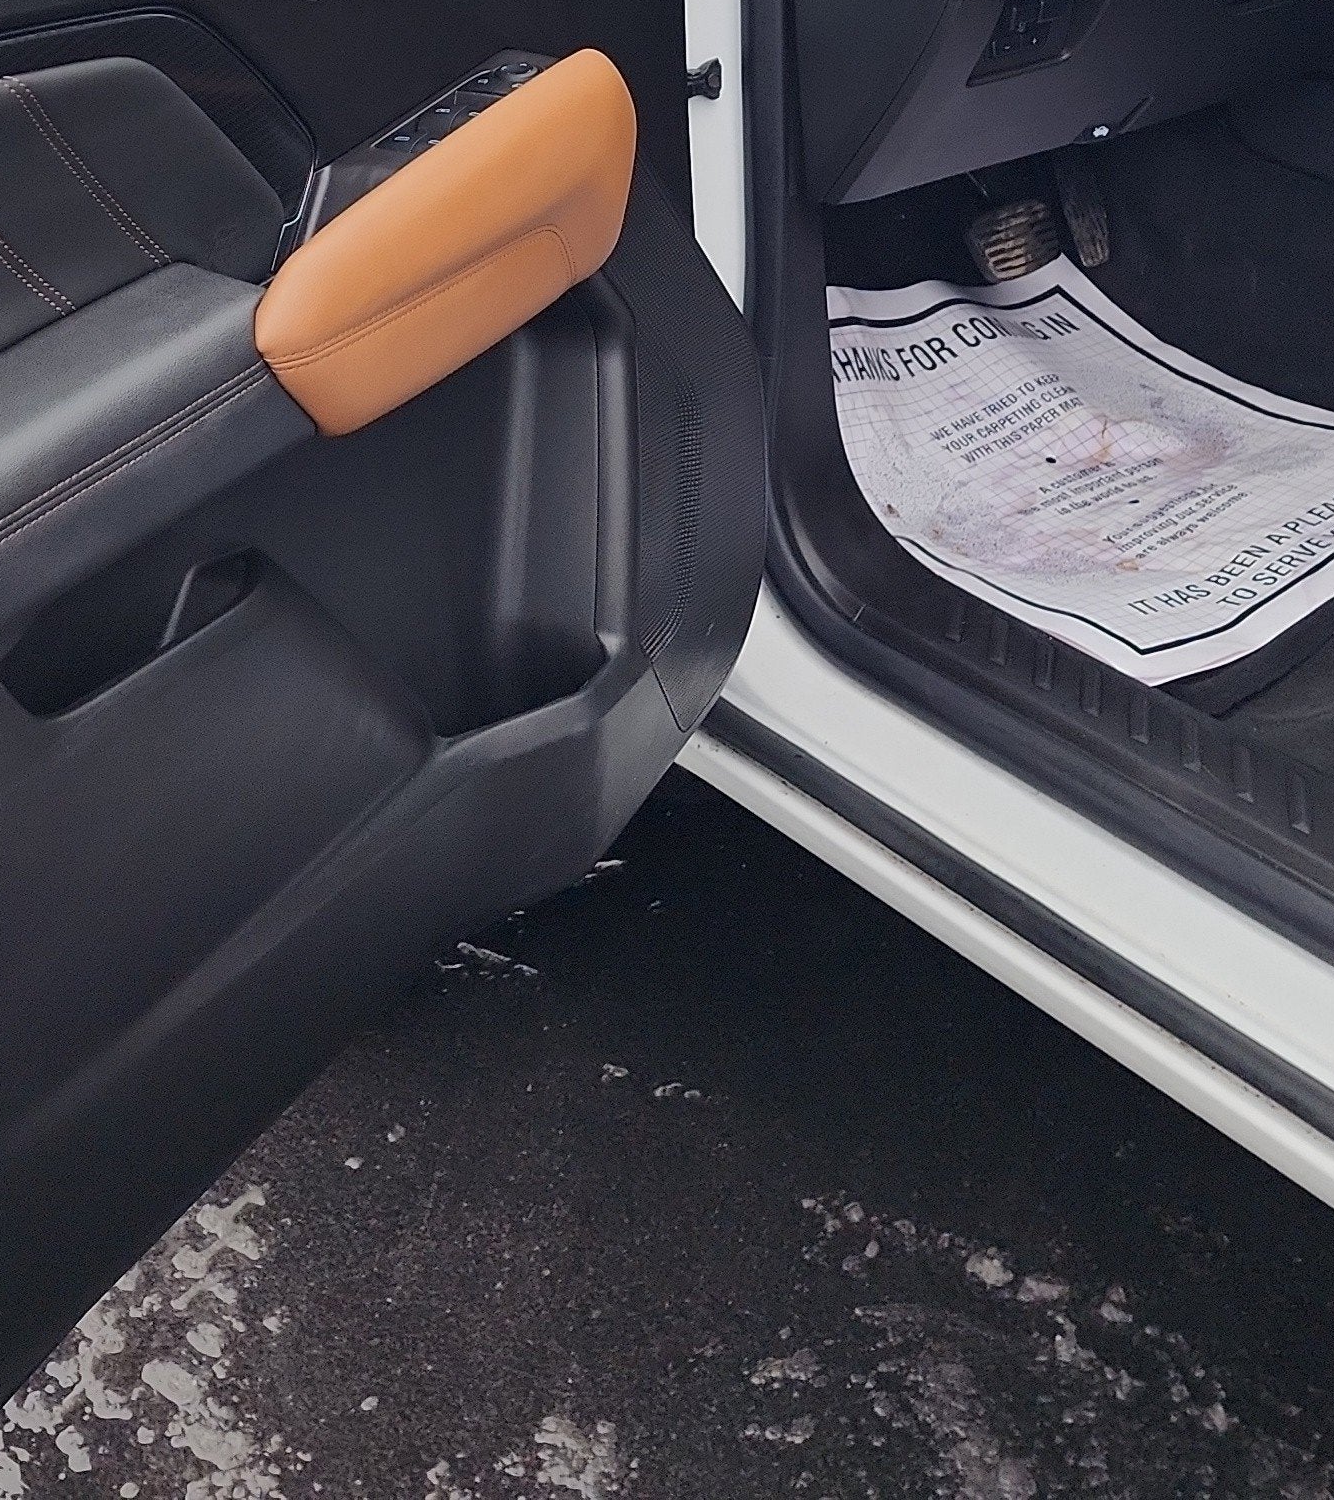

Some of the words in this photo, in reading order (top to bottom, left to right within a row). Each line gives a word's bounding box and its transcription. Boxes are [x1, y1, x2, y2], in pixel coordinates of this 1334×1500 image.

[896, 336, 959, 378] FOR
[1041, 312, 1082, 337] IN
[930, 426, 954, 442] WE
[951, 411, 984, 432] HAVE
[981, 393, 1018, 418] TRIED
[1017, 381, 1036, 397] TO
[942, 431, 979, 453] YOUR
[976, 399, 1042, 439] CARPETING
[960, 444, 995, 464] WITH
[992, 431, 1023, 450] THIS
[1020, 407, 1061, 437] PAPER
[1068, 470, 1127, 495] important
[1102, 527, 1134, 545] Your
[1117, 517, 1179, 553] improving
[1175, 506, 1197, 521] our
[1135, 545, 1158, 559] are
[1156, 523, 1199, 546] always
[1127, 599, 1159, 616] IT
[1154, 583, 1212, 608] HAS
[1205, 544, 1273, 587] BEEN
[1265, 531, 1292, 546] A
[1215, 586, 1259, 608] TO
[1252, 536, 1332, 586] SERVE
